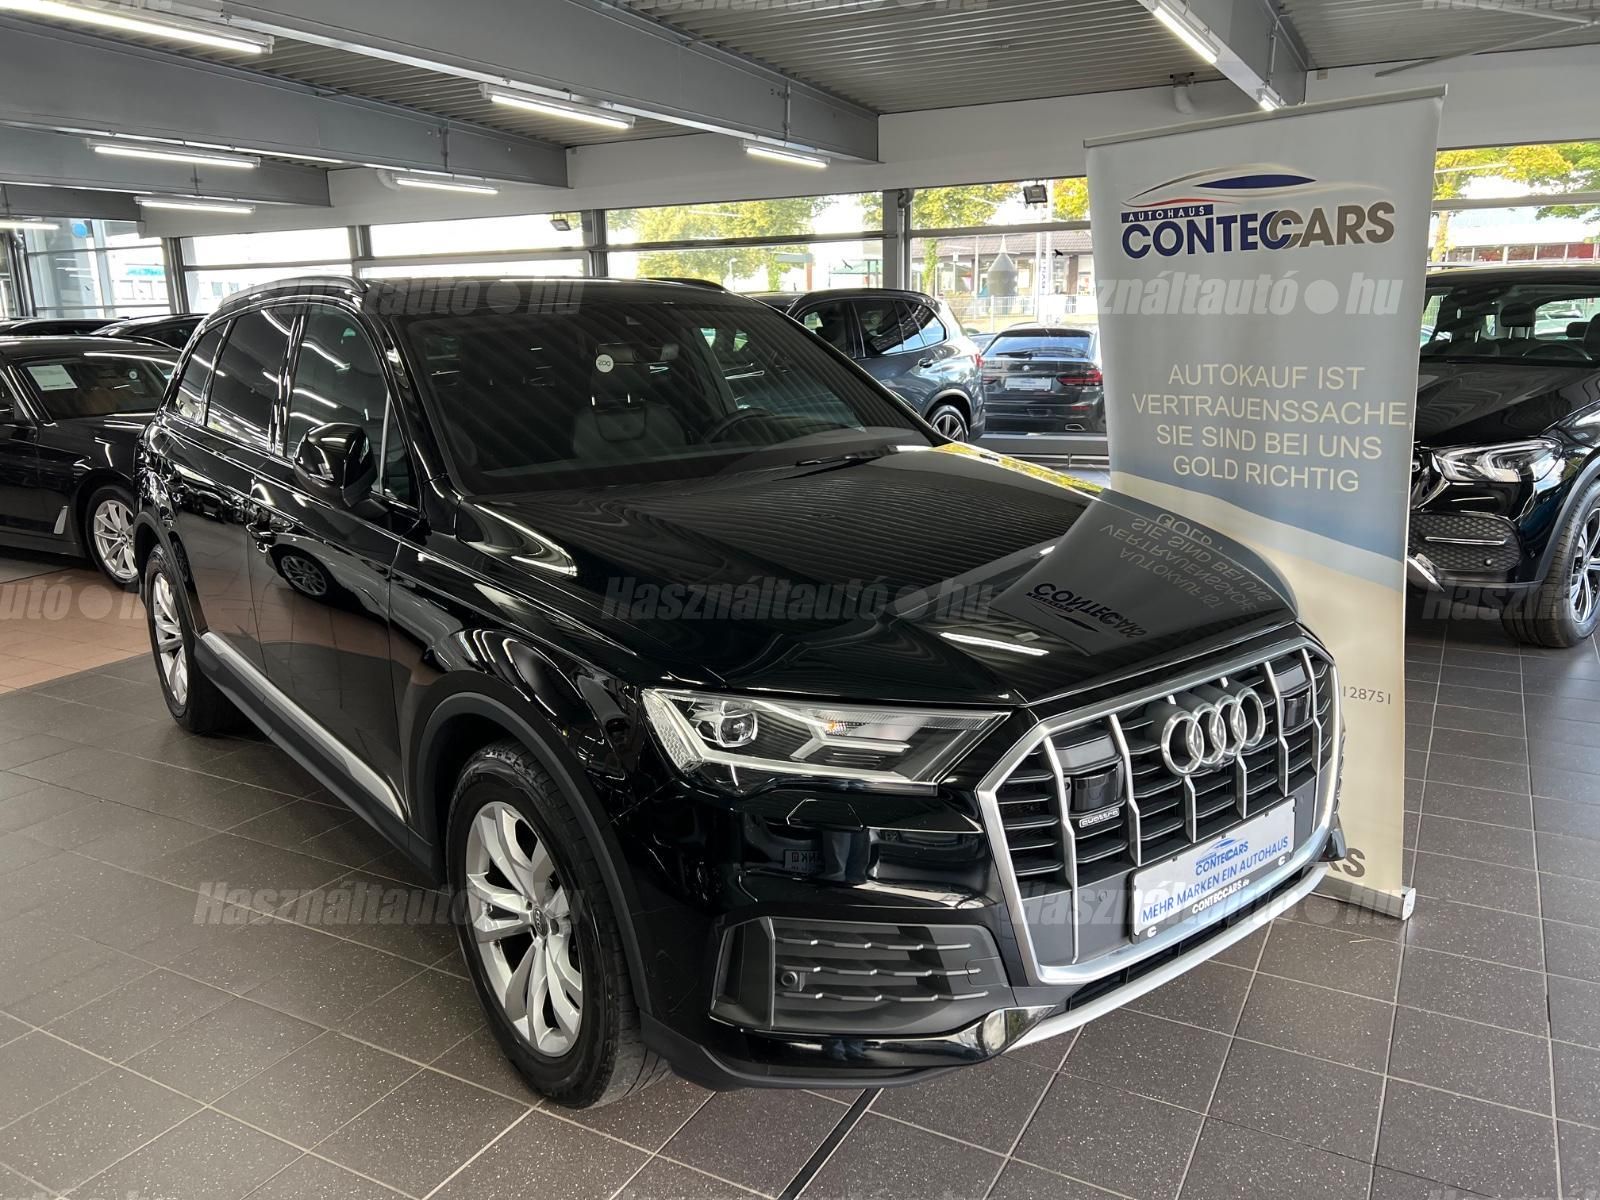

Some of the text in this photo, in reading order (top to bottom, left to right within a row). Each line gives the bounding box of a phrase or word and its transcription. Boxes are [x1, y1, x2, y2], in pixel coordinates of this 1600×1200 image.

[1128, 206, 1206, 222] AUTOHAUS
[1168, 363, 1365, 391] AUTOKAUF IST
[1156, 424, 1382, 460] SIE SIND BEI UNS
[1173, 455, 1359, 493] GOLD RICHTIG
[1142, 896, 1174, 923] MEHR
[1177, 876, 1224, 905] MARKEN
[1222, 864, 1237, 882] EIN
[1240, 836, 1289, 871] AUTOHAUS
